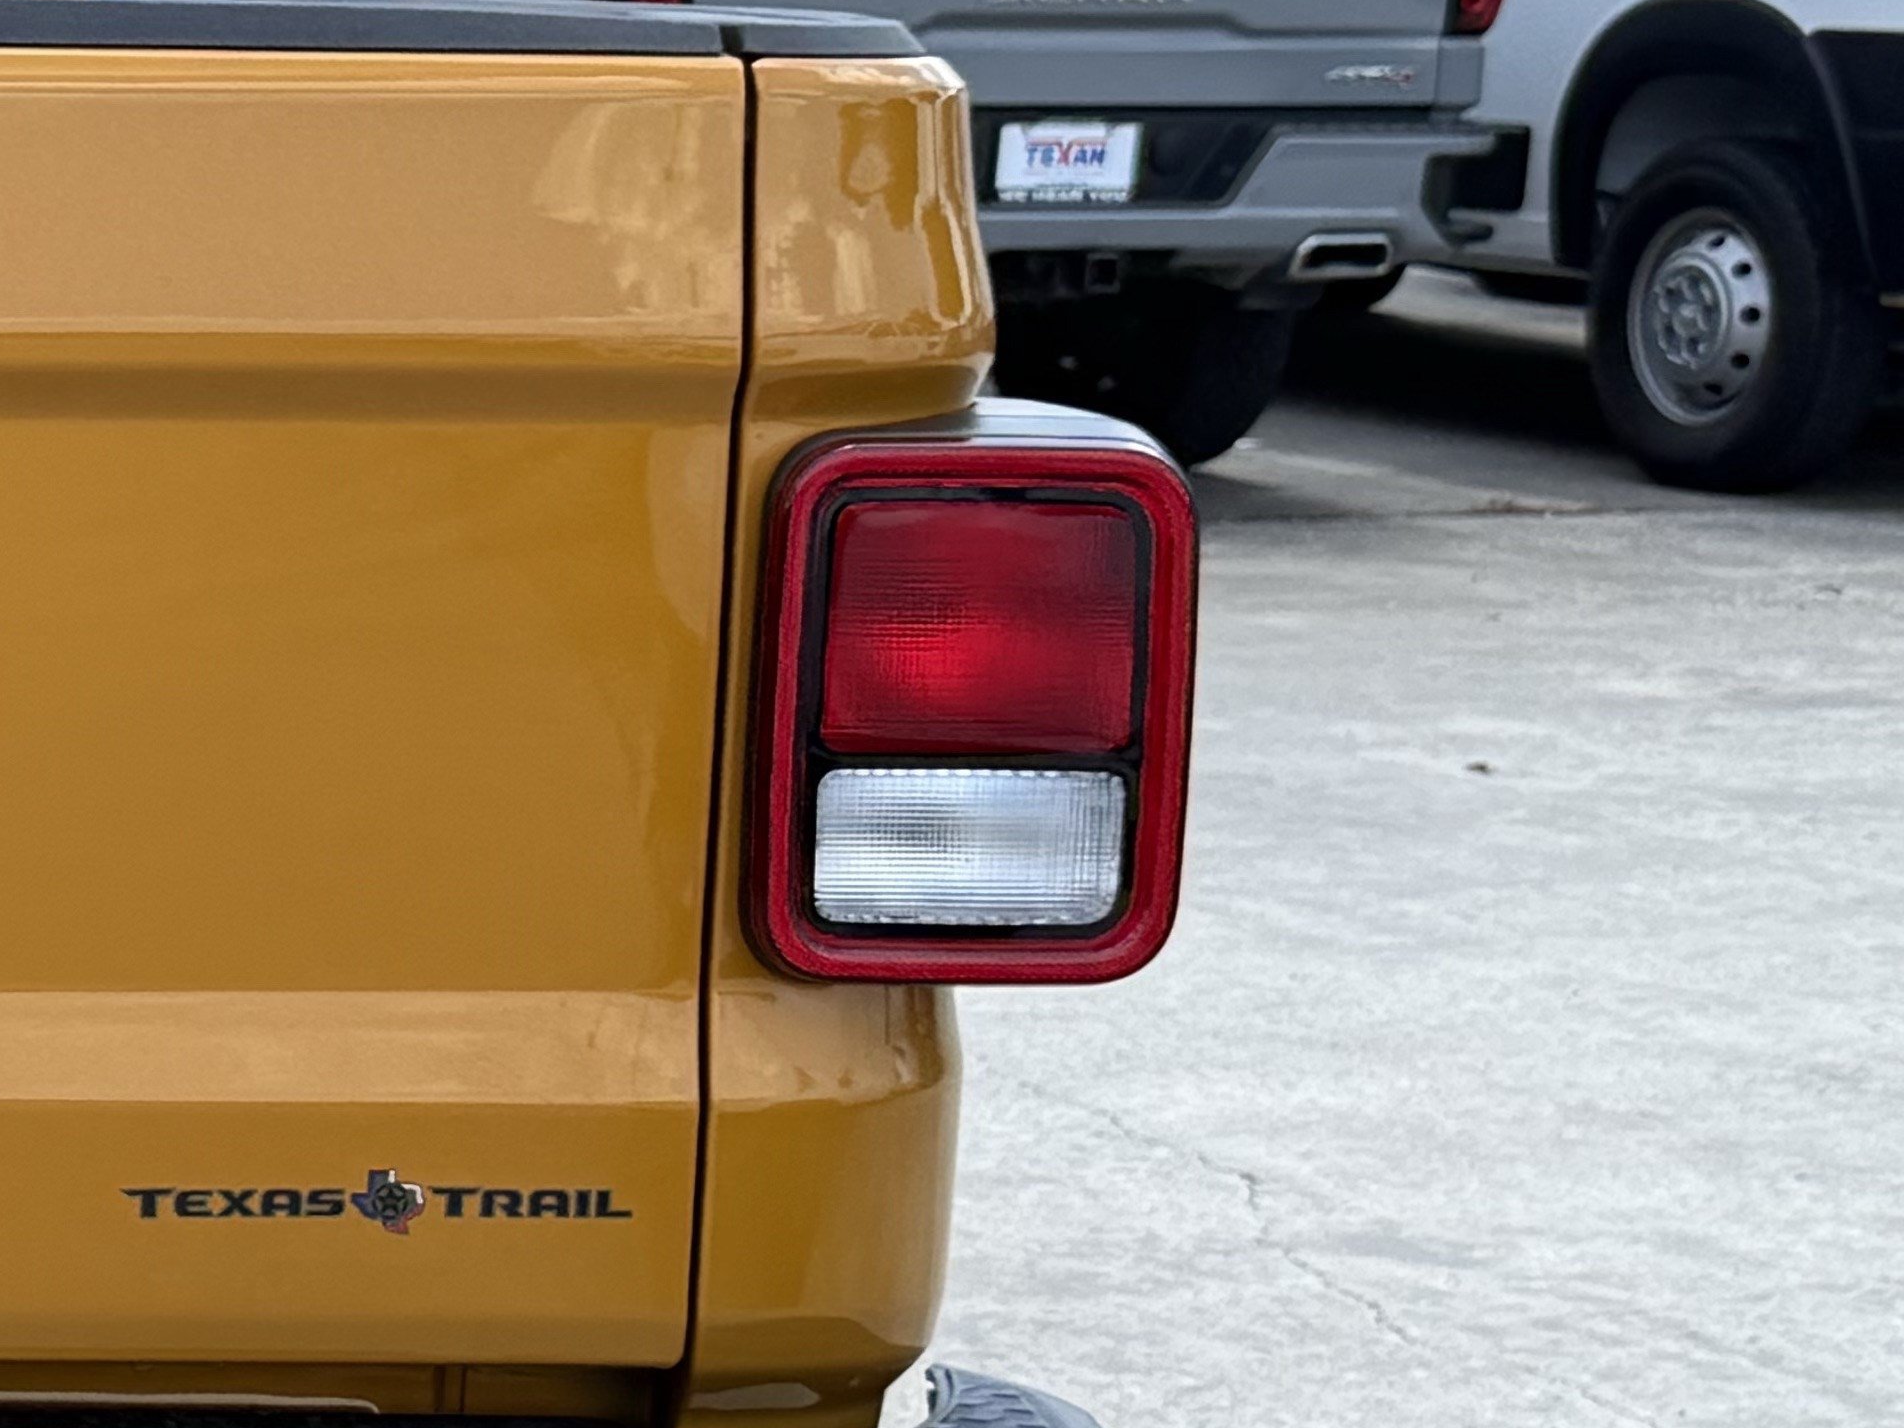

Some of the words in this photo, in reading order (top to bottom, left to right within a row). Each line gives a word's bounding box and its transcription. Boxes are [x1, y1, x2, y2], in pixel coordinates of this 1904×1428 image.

[1026, 142, 1107, 167] TEXAN
[118, 1187, 347, 1220] TEXAS
[427, 1185, 634, 1220] TRAIL
